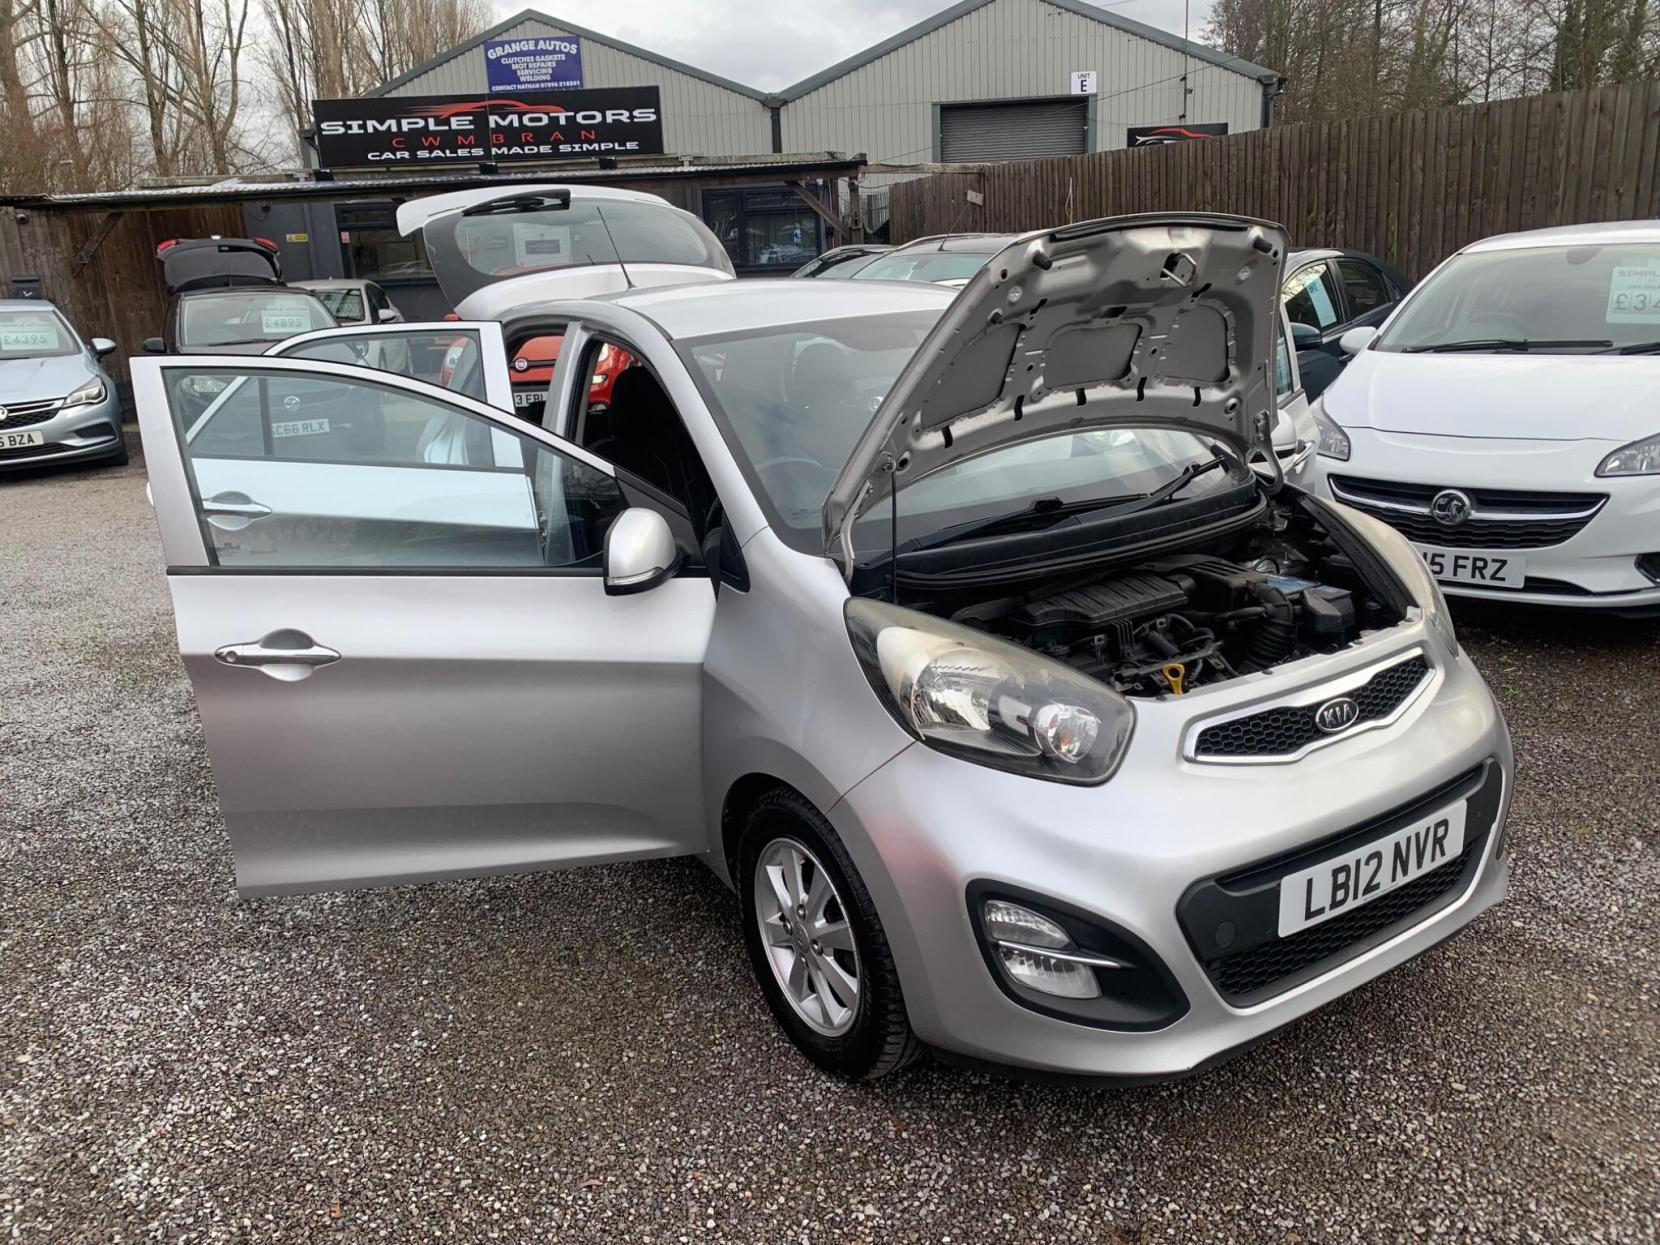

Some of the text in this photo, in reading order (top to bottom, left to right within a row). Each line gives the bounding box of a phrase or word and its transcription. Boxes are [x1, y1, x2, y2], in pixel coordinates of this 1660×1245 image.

[487, 40, 578, 59] GRANGE AUTOS
[501, 54, 566, 64] CLUTCHES GASKETS
[511, 61, 557, 70] MOT REPAIRS
[516, 68, 553, 76] SERVICING
[519, 74, 552, 82] WELDING
[491, 83, 517, 91] CONTACT
[1080, 79, 1088, 92] E
[320, 108, 657, 135] SIMPLE MOTORS
[392, 130, 596, 148] CWMBRAN
[367, 141, 640, 160] CAR SALES MADE SIMPLE
[302, 421, 325, 433] RLX
[7, 432, 35, 446] BZA
[1453, 555, 1508, 582] FRZ
[1323, 703, 1354, 727] KIA
[1304, 818, 1449, 921] LB12 NVR
